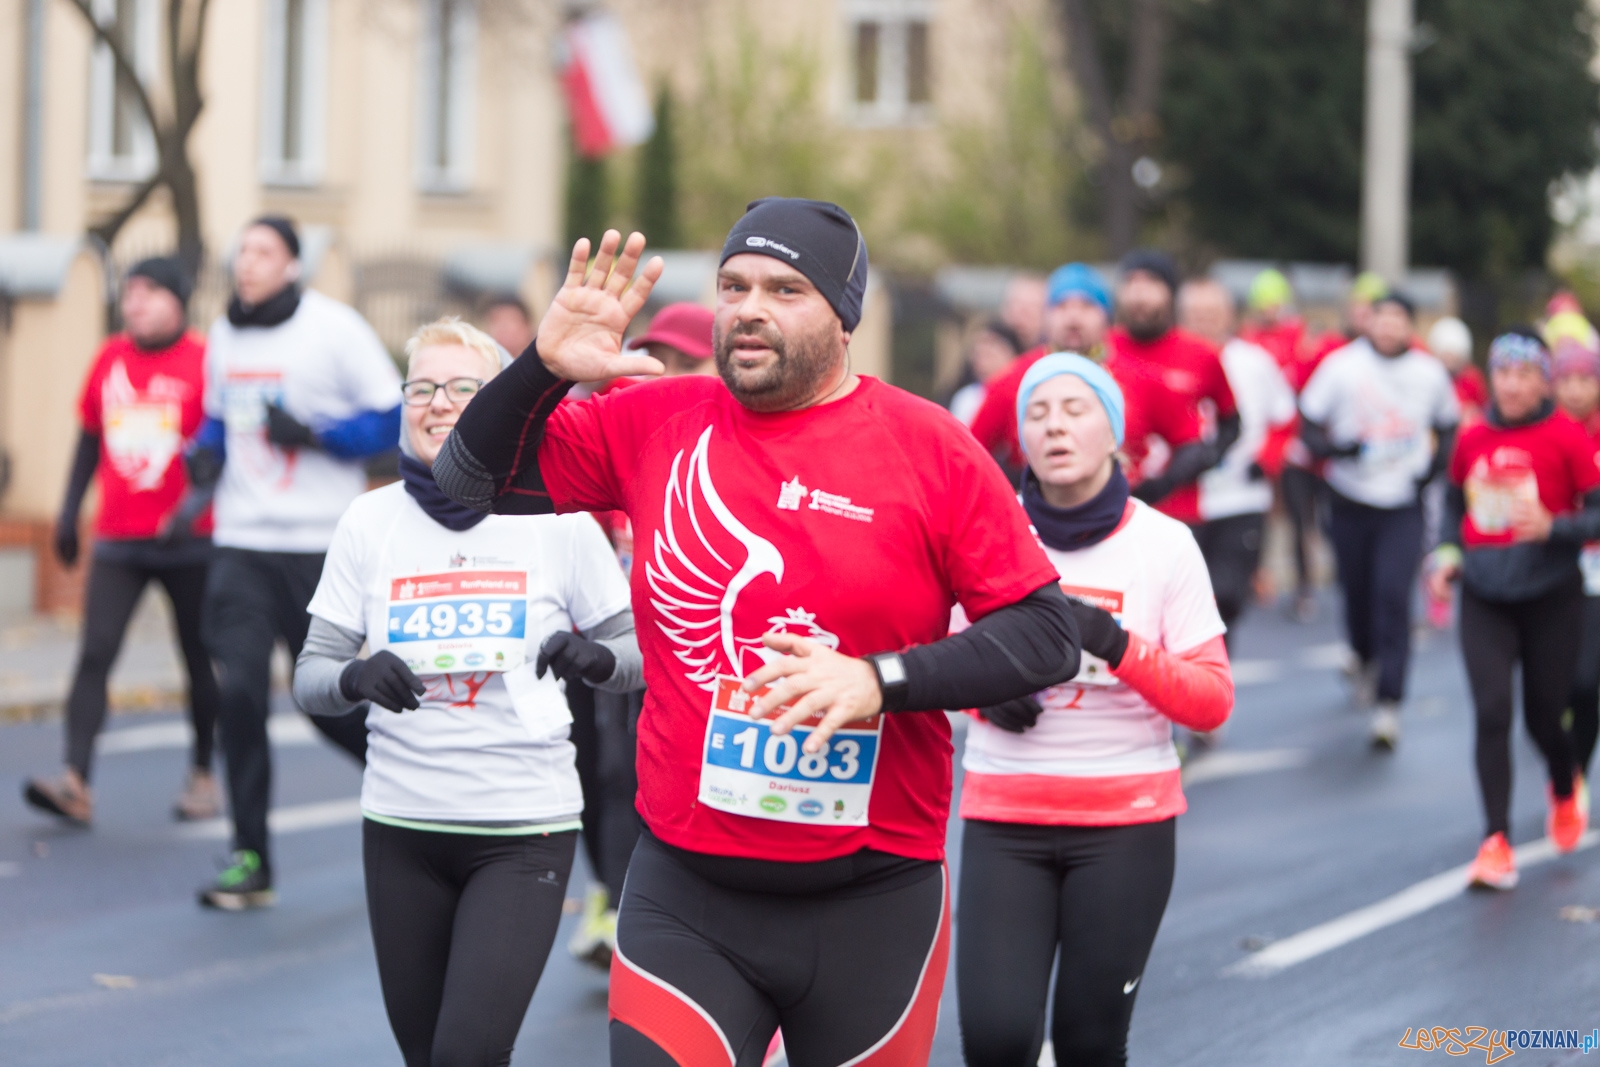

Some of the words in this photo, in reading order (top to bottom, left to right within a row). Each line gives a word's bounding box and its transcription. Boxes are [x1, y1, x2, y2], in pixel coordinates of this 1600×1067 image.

[403, 602, 513, 638] 4935
[711, 733, 725, 749] E
[732, 727, 860, 780] 1083
[769, 781, 811, 794] Dariusz
